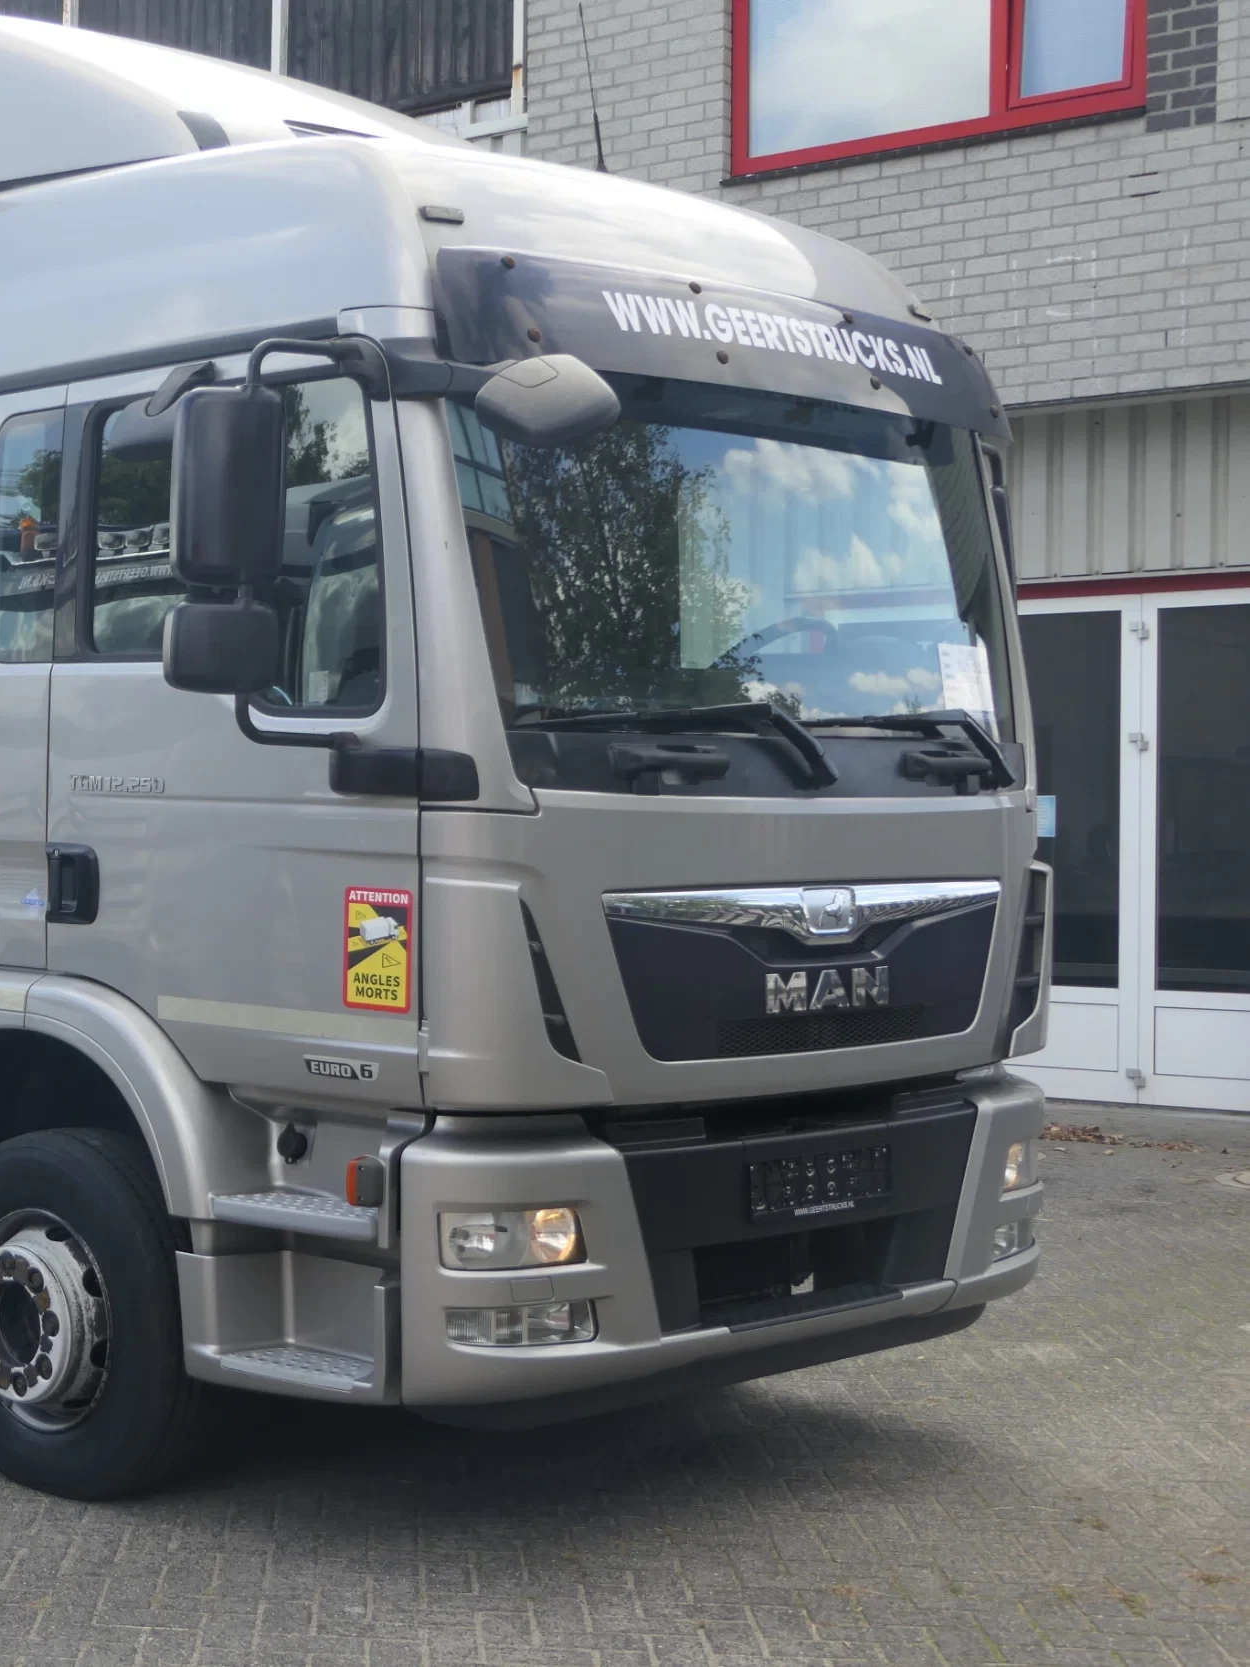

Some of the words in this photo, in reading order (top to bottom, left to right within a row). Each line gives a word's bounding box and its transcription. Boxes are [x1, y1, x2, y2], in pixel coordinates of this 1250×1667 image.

[601, 290, 943, 386] WWW.GEERTSTRUCKS.NL
[349, 890, 409, 904] ATTENTION
[353, 972, 400, 987] ANGLES
[355, 986, 398, 1001] MORTS
[765, 965, 889, 1014] MAN
[310, 1061, 352, 1078] EURO
[360, 1064, 373, 1079] 6
